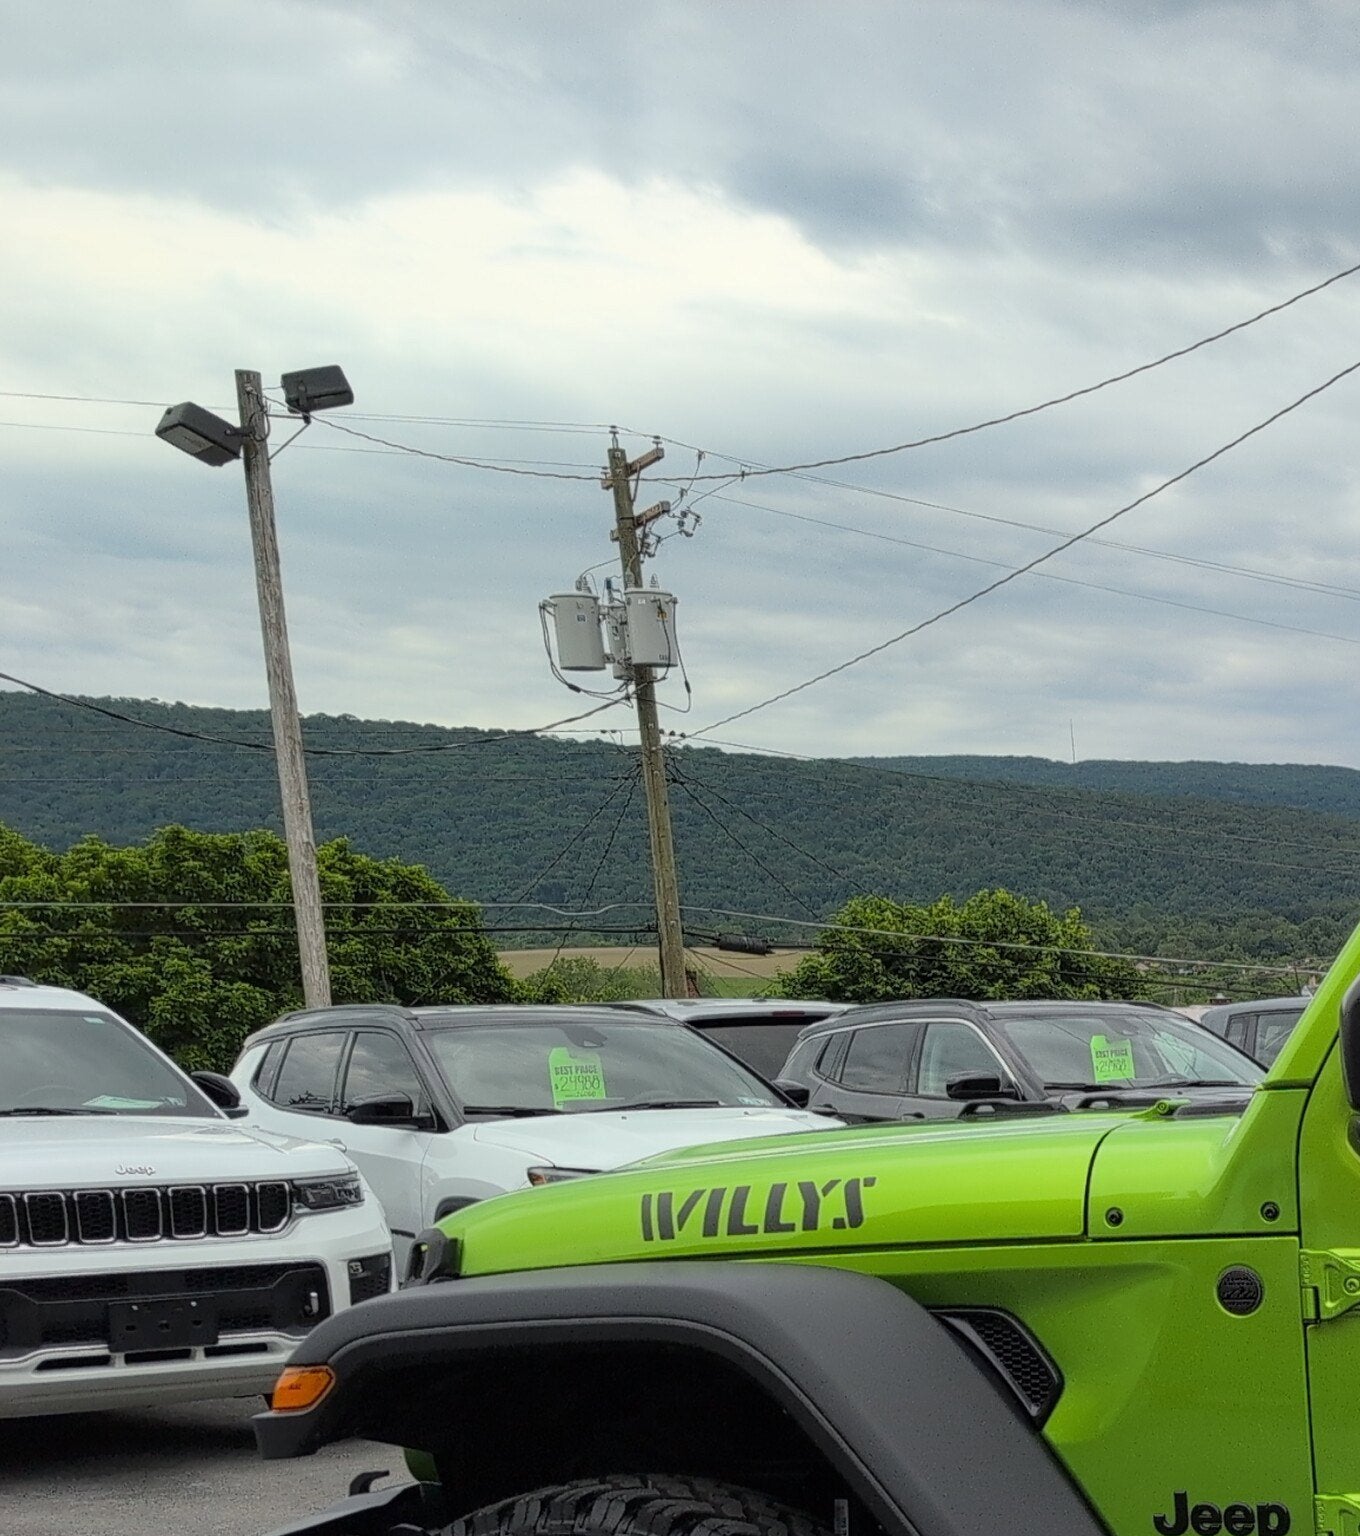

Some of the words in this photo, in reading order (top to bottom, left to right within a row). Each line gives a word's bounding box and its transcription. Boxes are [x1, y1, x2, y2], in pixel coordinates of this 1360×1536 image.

[554, 1066, 573, 1076] BEST
[574, 1065, 598, 1074] PRICE
[115, 1164, 156, 1176] Jeep
[641, 1177, 876, 1242] WILLYS
